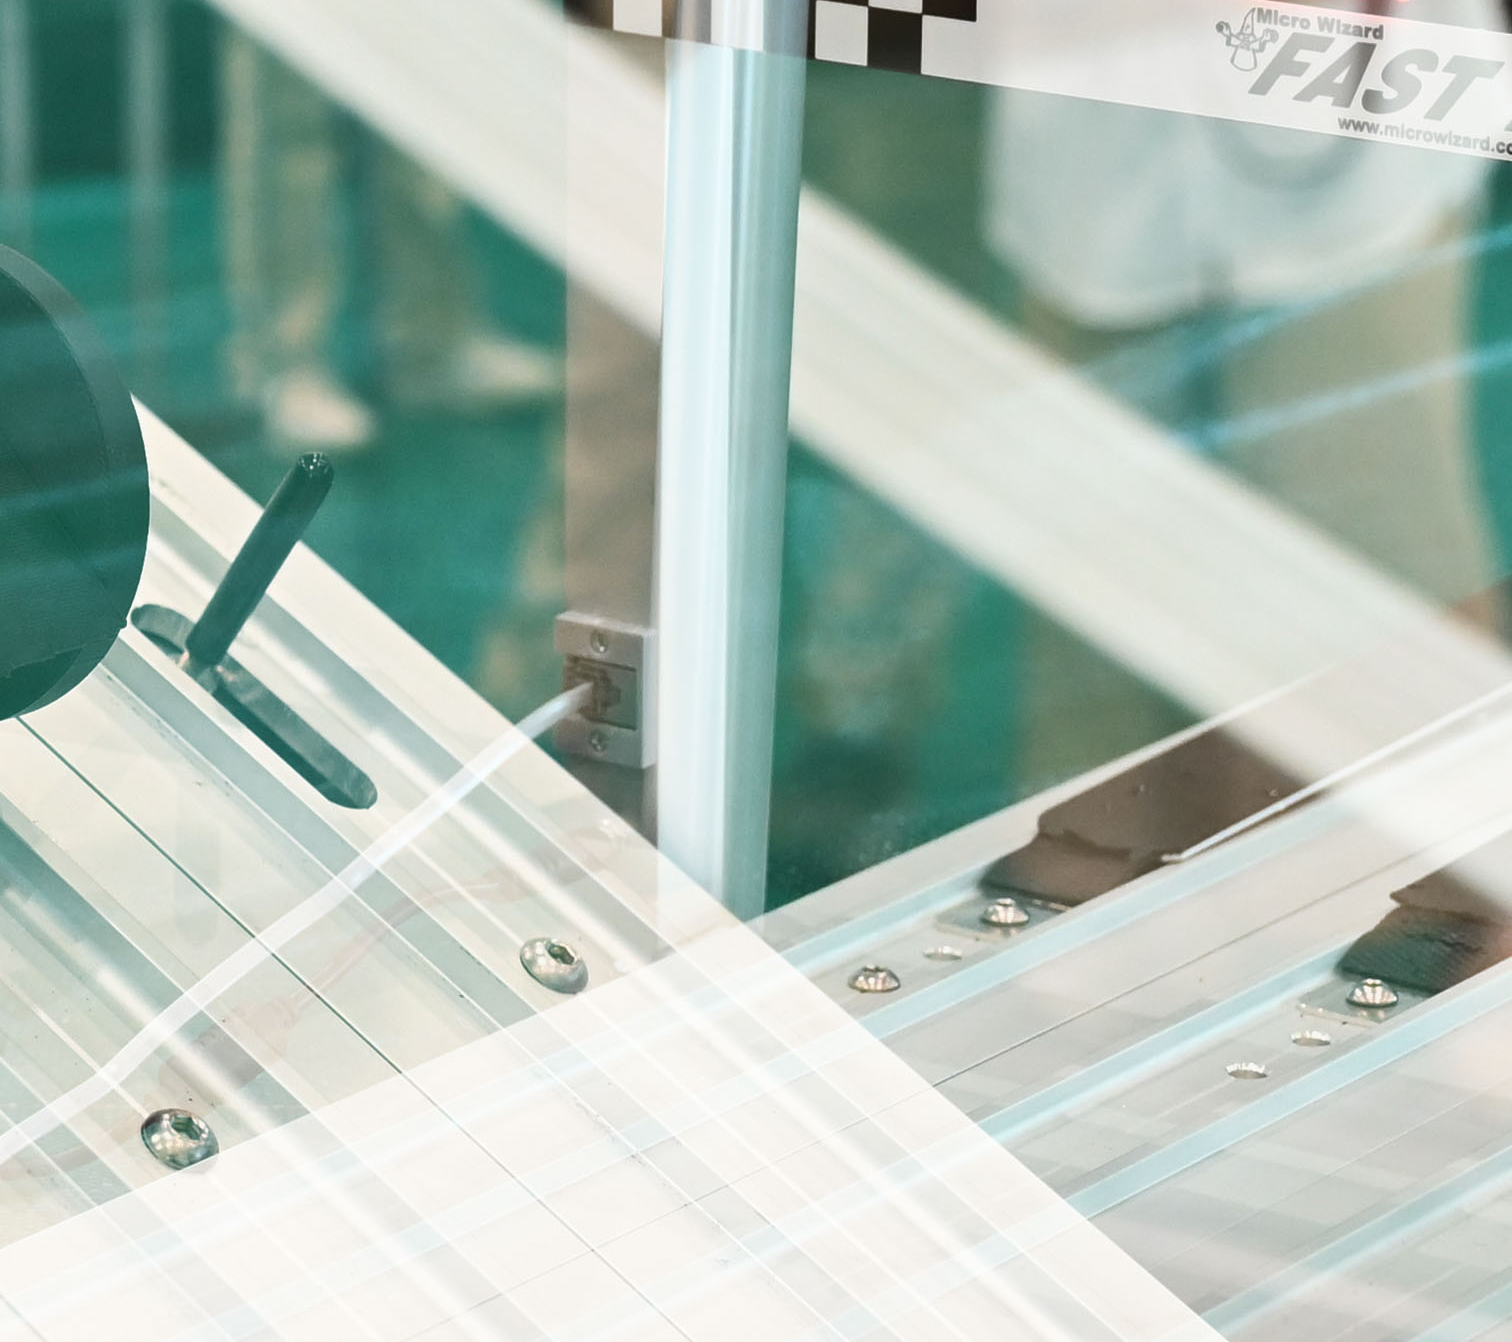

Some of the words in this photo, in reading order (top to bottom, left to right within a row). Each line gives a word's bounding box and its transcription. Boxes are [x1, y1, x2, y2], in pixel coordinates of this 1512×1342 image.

[1256, 8, 1311, 30] Micro
[1317, 15, 1384, 41] Wizard
[1248, 32, 1506, 122] FAST
